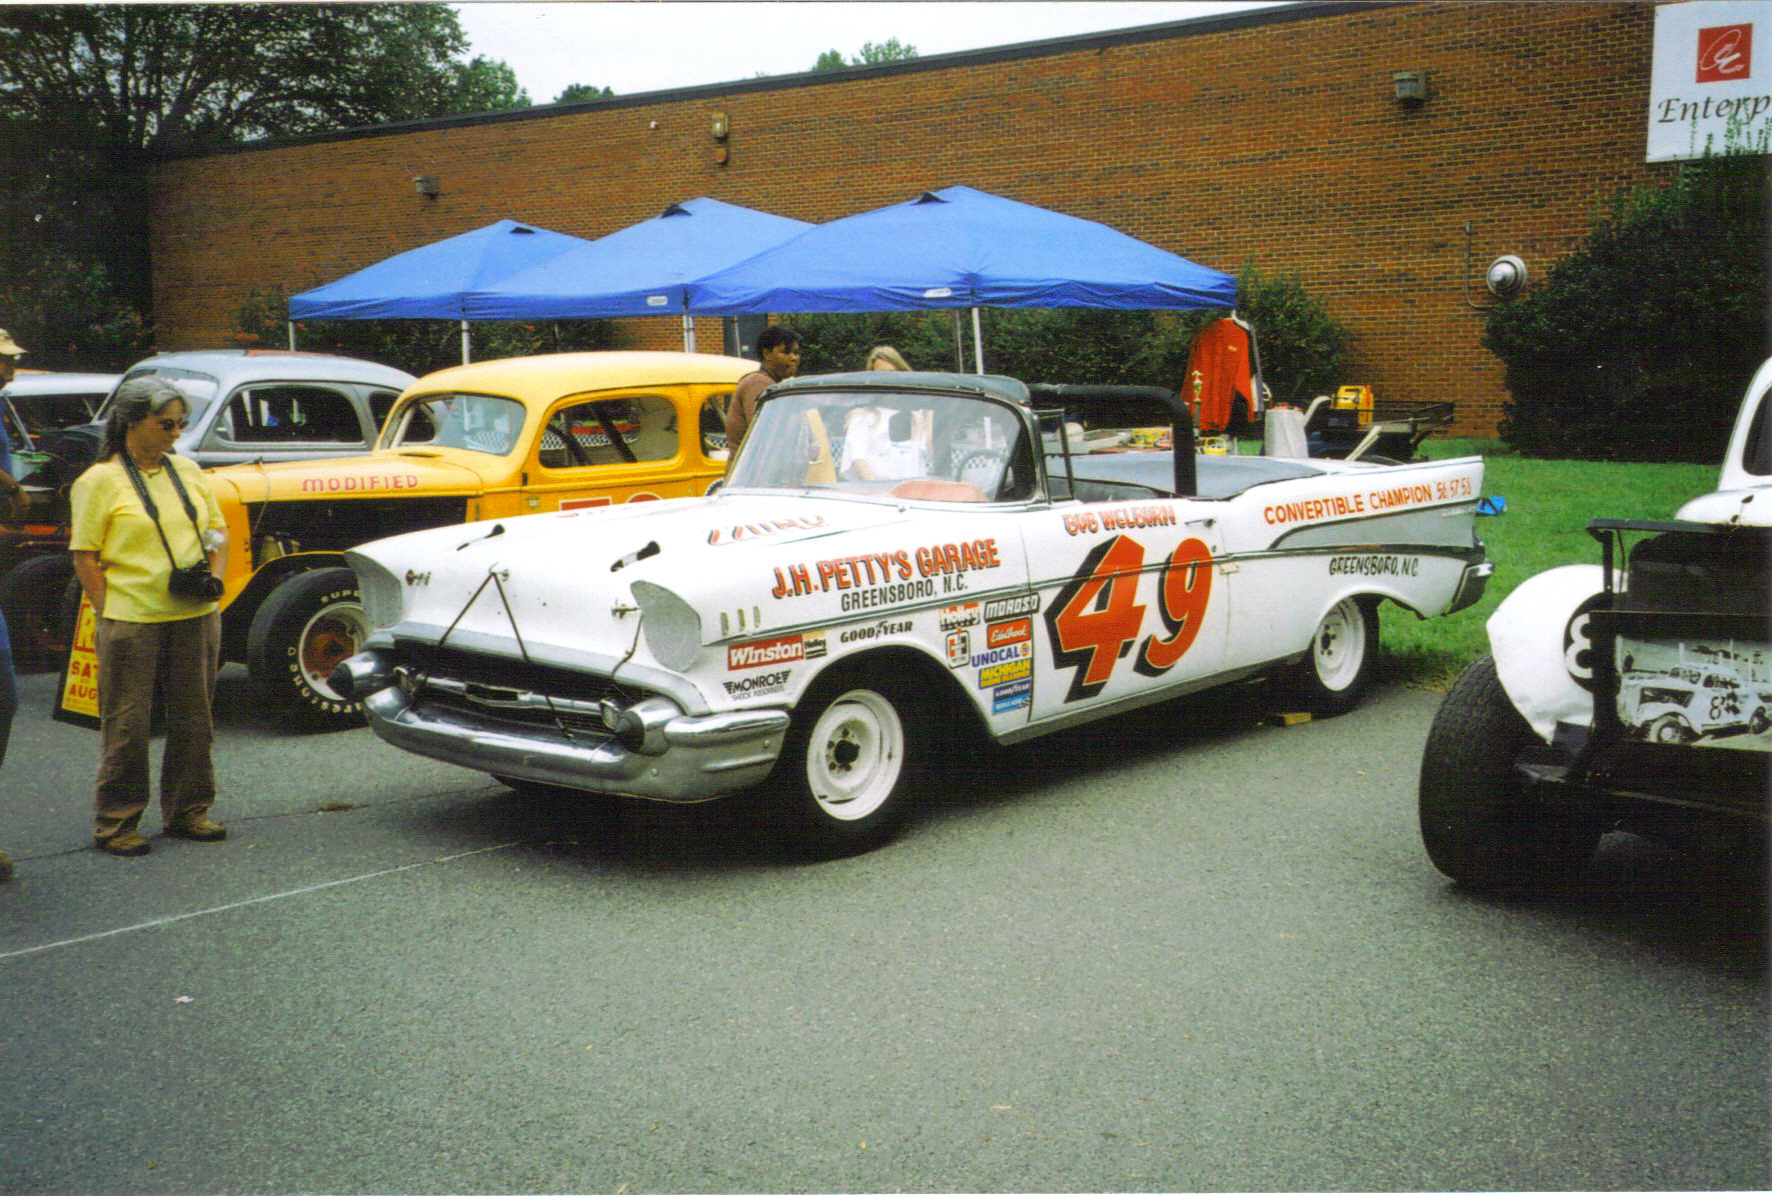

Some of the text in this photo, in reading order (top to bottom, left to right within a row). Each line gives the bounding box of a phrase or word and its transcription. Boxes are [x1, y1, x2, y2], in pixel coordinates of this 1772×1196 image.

[302, 474, 418, 493] MODIFIED
[1264, 493, 1365, 525] CONVERTIBLE
[1369, 484, 1433, 510] CHAMPION
[1063, 512, 1100, 537] BOB
[772, 538, 1001, 600] J.H. PETTY'S GARAGE
[943, 574, 969, 594] N.C.
[1045, 534, 1214, 703] 49
[729, 640, 804, 668] Winston
[971, 646, 1021, 668] UNOCAL
[731, 672, 784, 694] MONROE
